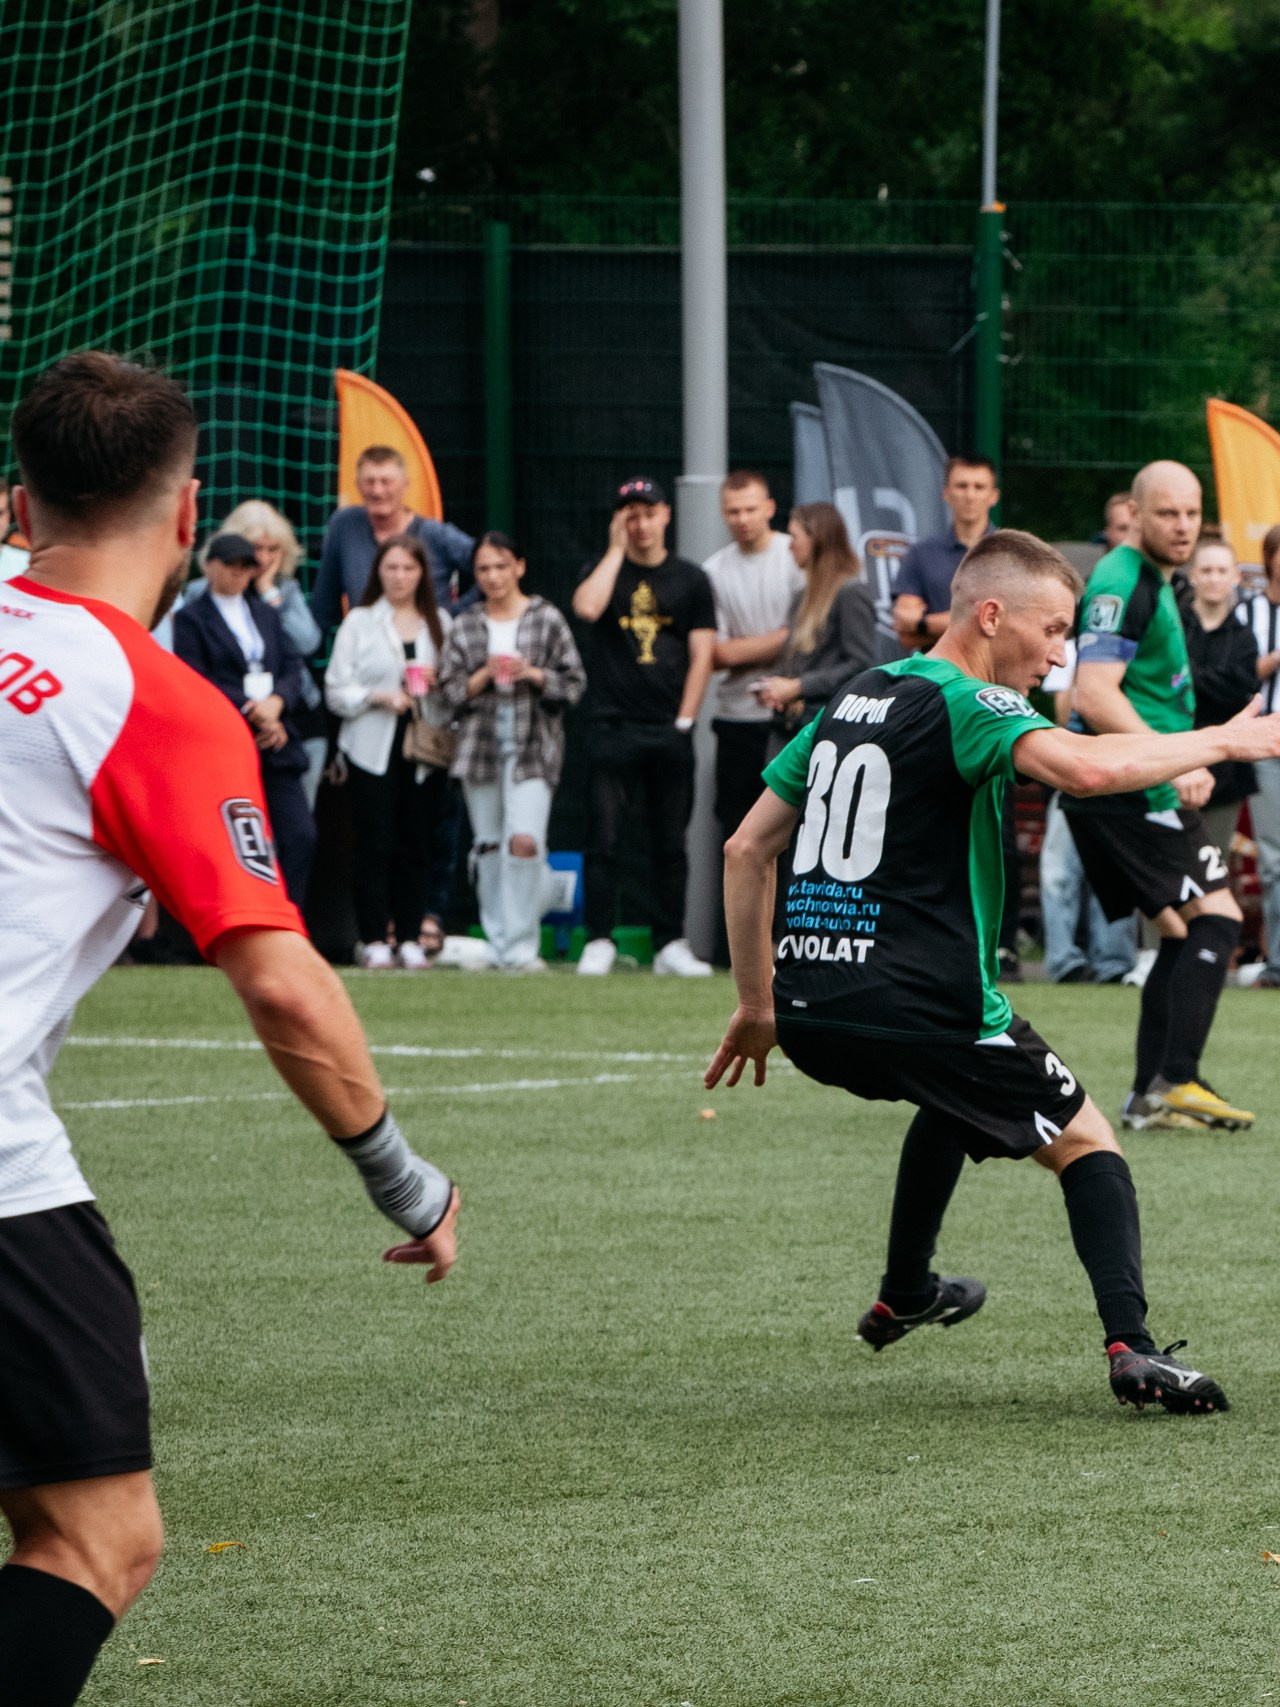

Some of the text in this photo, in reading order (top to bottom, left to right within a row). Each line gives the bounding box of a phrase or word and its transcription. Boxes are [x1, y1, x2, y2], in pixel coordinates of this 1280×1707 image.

[0, 649, 64, 715] ОВ
[792, 739, 892, 882] 30
[1198, 845, 1229, 881] 2
[1045, 1052, 1077, 1096] 3
